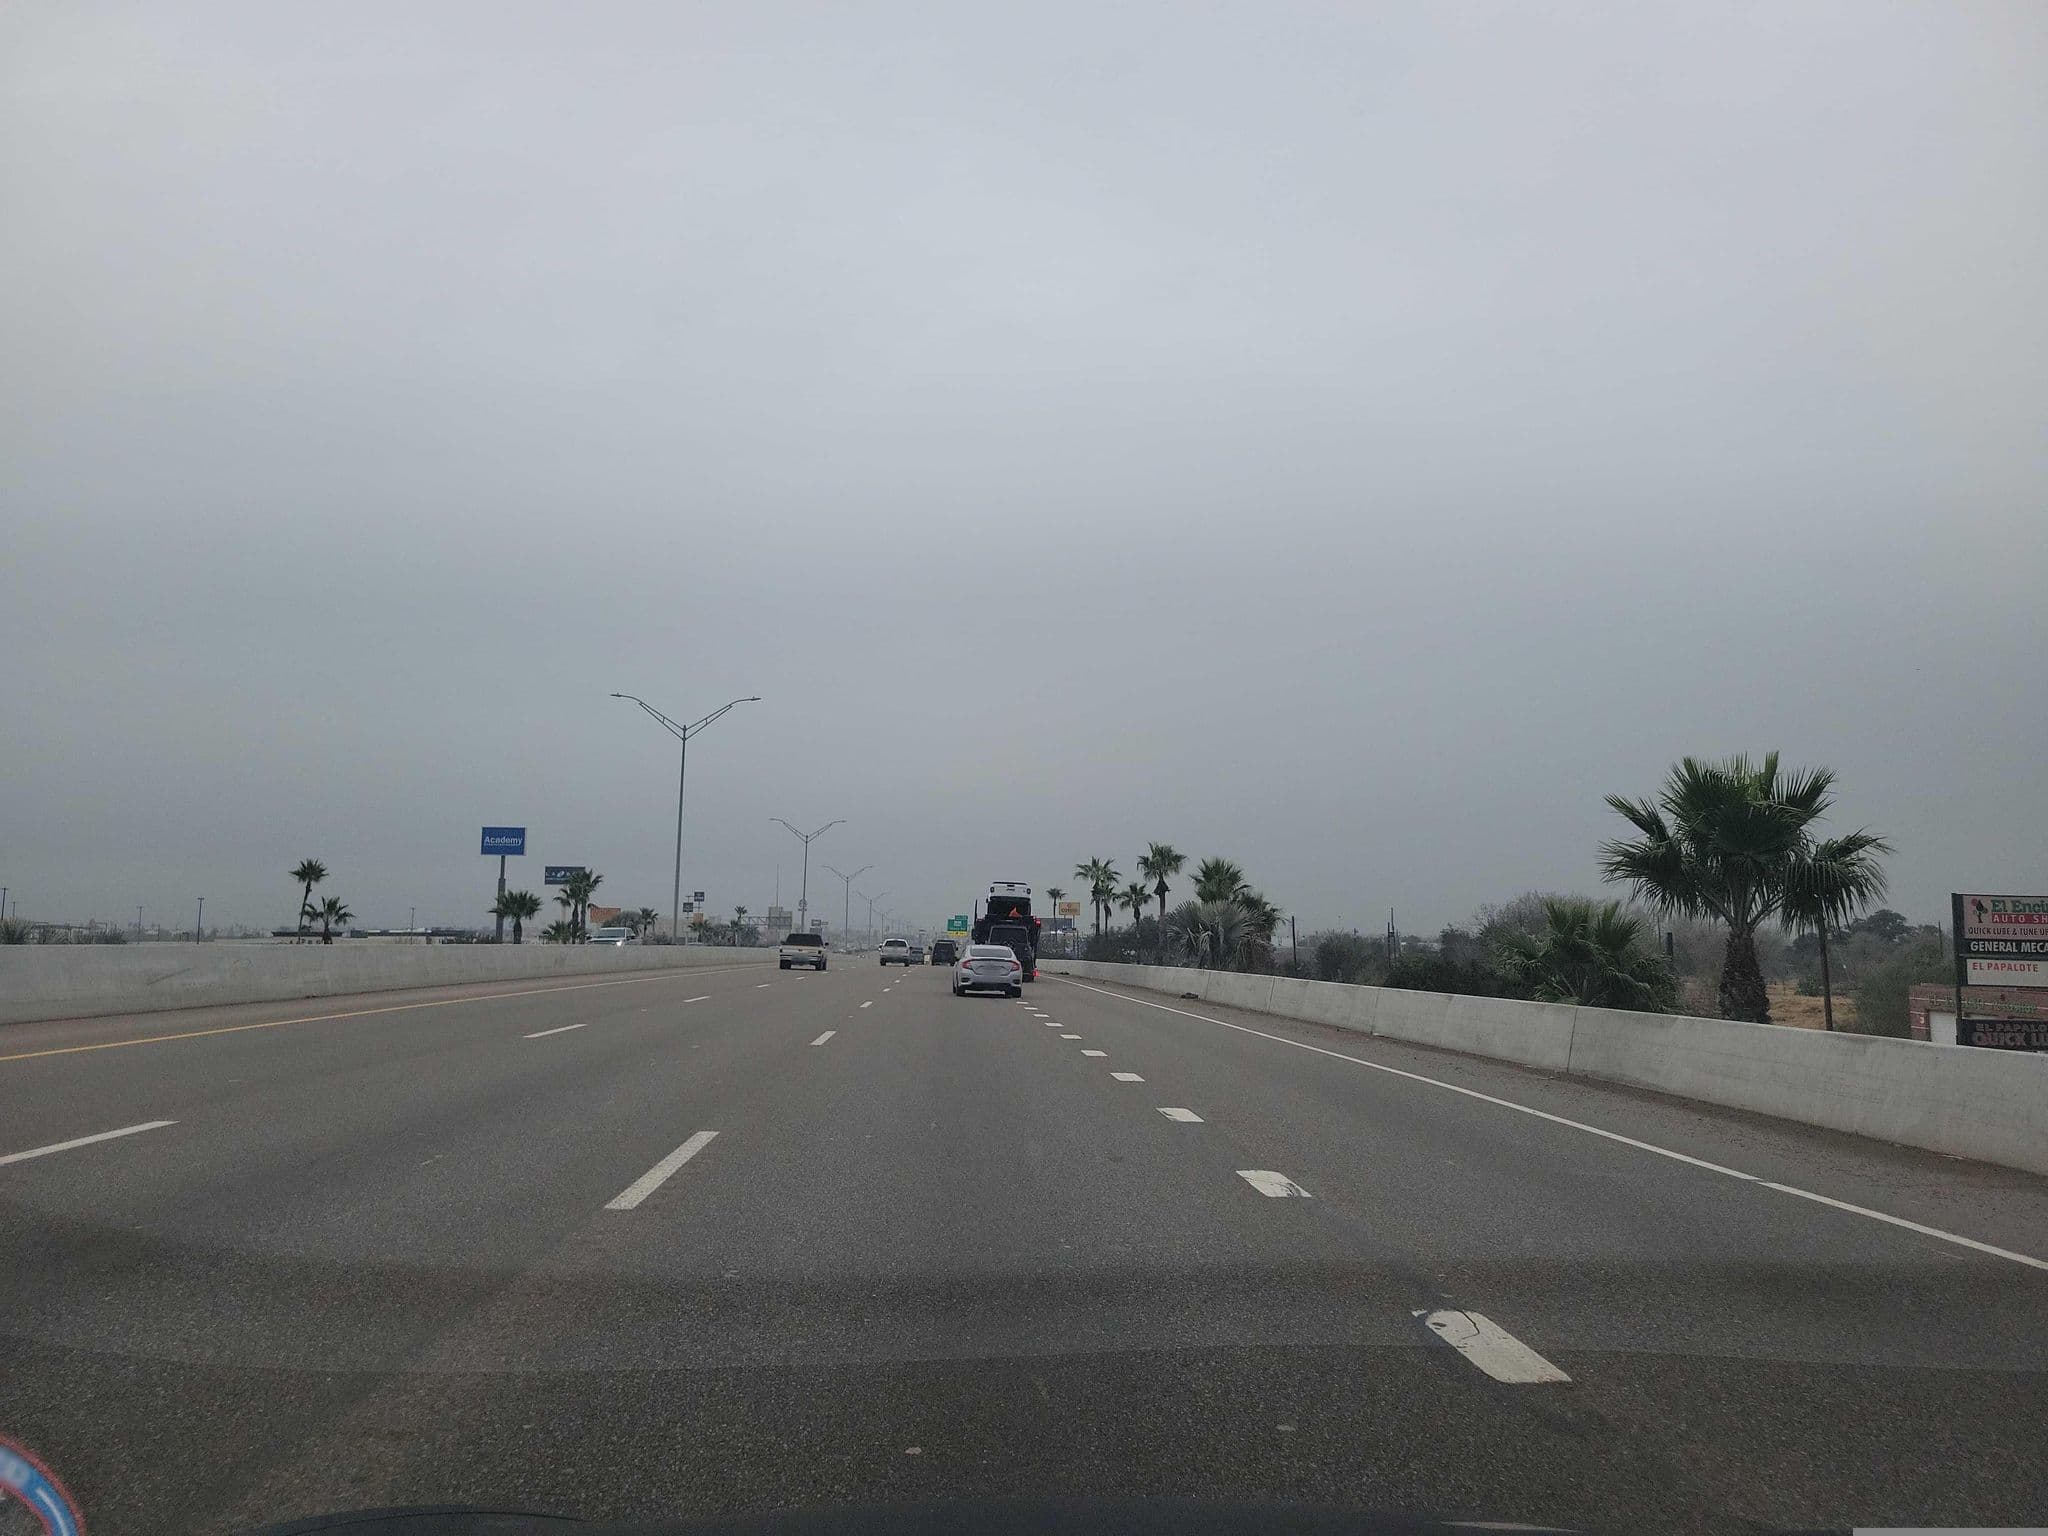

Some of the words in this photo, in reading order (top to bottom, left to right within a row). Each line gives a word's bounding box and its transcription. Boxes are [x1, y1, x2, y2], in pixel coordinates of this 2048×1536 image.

[484, 836, 523, 846] Academy
[1991, 899, 2008, 913] El
[1993, 914, 2026, 923] AUTO
[1968, 926, 1992, 935] QUICK
[2020, 927, 2038, 936] TUNE
[1970, 941, 2018, 953] GENERAL
[1972, 962, 1984, 971] EL
[1987, 962, 2039, 973] PAPALOTE
[1975, 1023, 1993, 1032] EL
[1971, 1032, 2027, 1047] QUICK
